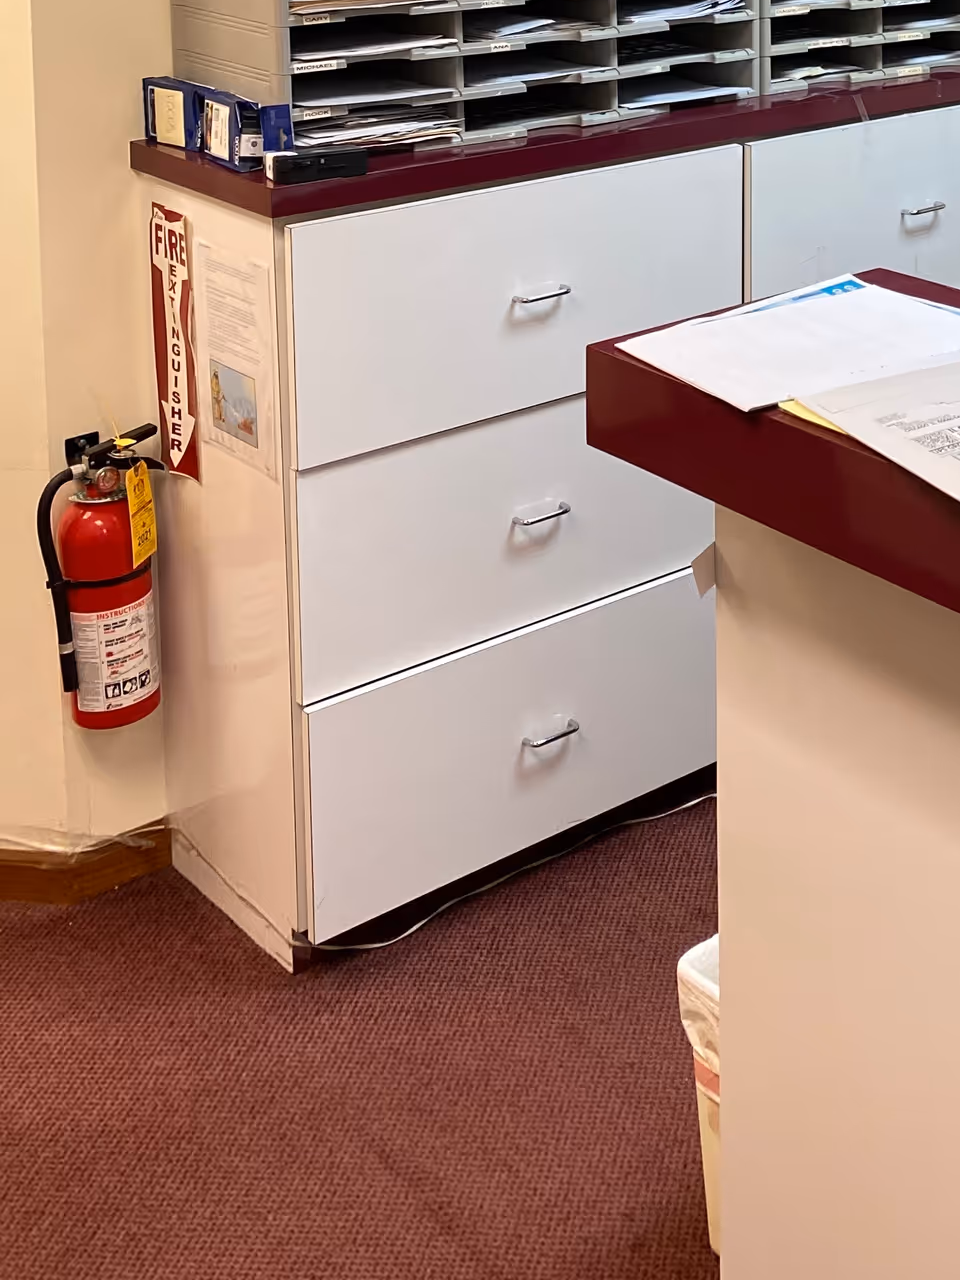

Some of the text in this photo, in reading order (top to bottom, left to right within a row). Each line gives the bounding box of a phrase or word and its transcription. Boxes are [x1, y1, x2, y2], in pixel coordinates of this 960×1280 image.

[296, 63, 335, 71] MICHAEL
[155, 222, 186, 267] FIRE
[168, 263, 183, 453] EXTINGUISHER
[137, 527, 152, 547] 2021
[97, 599, 146, 621] INSTRUCTIONS
